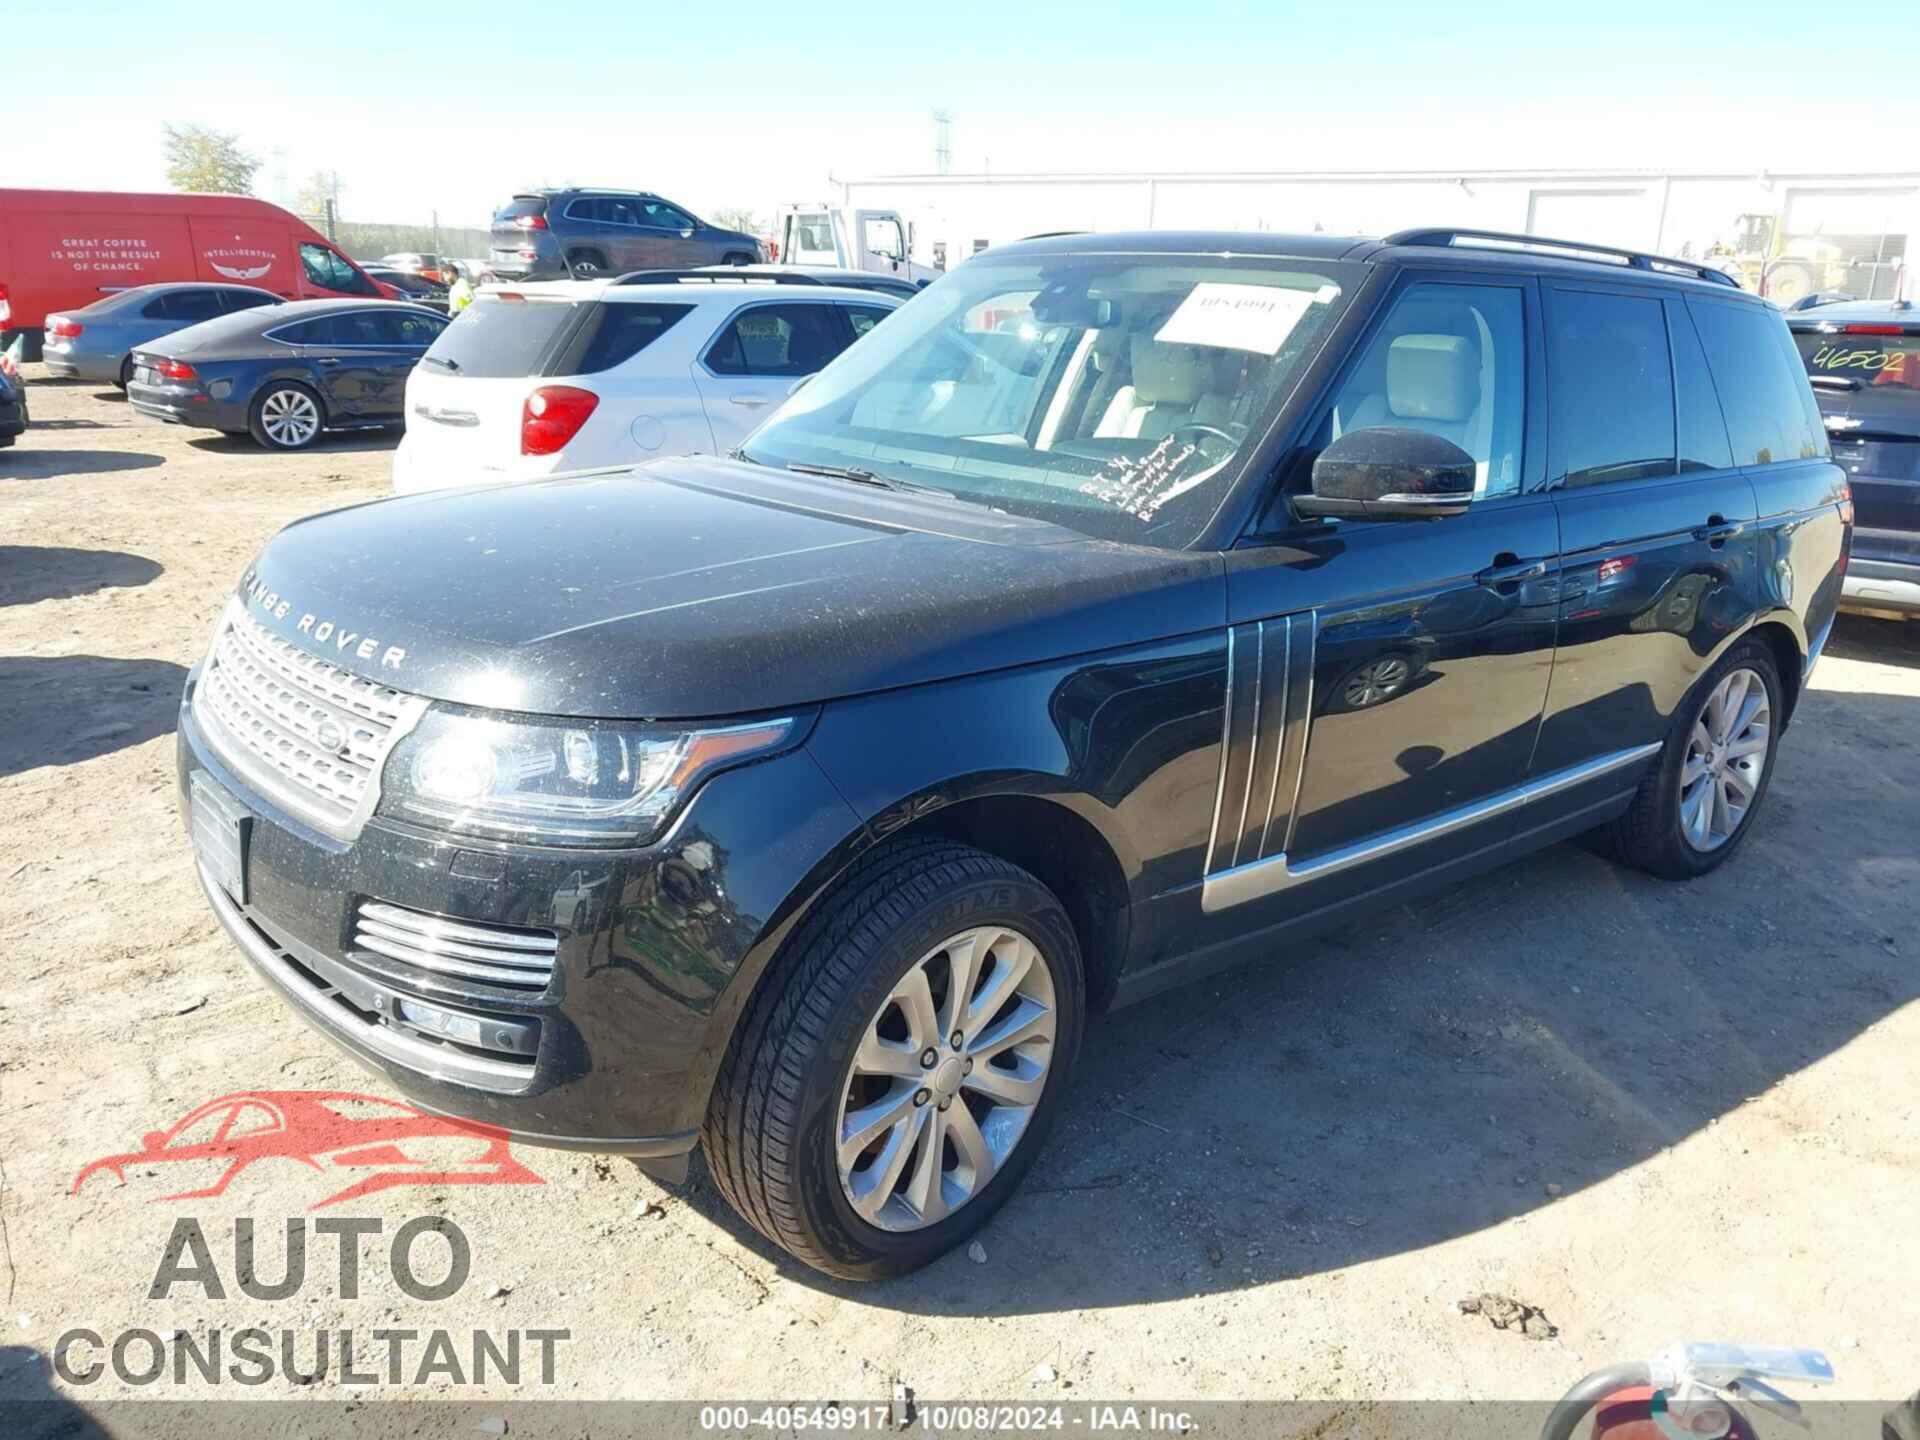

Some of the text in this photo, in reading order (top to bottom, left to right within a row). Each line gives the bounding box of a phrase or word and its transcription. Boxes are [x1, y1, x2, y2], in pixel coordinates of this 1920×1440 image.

[62, 239, 146, 247] GREAT COFFEE
[51, 251, 160, 259] IS NOT THE RESULT
[73, 263, 144, 271] OF CHANCE.
[1812, 346, 1905, 371] 46502
[297, 613, 406, 669] ROVER
